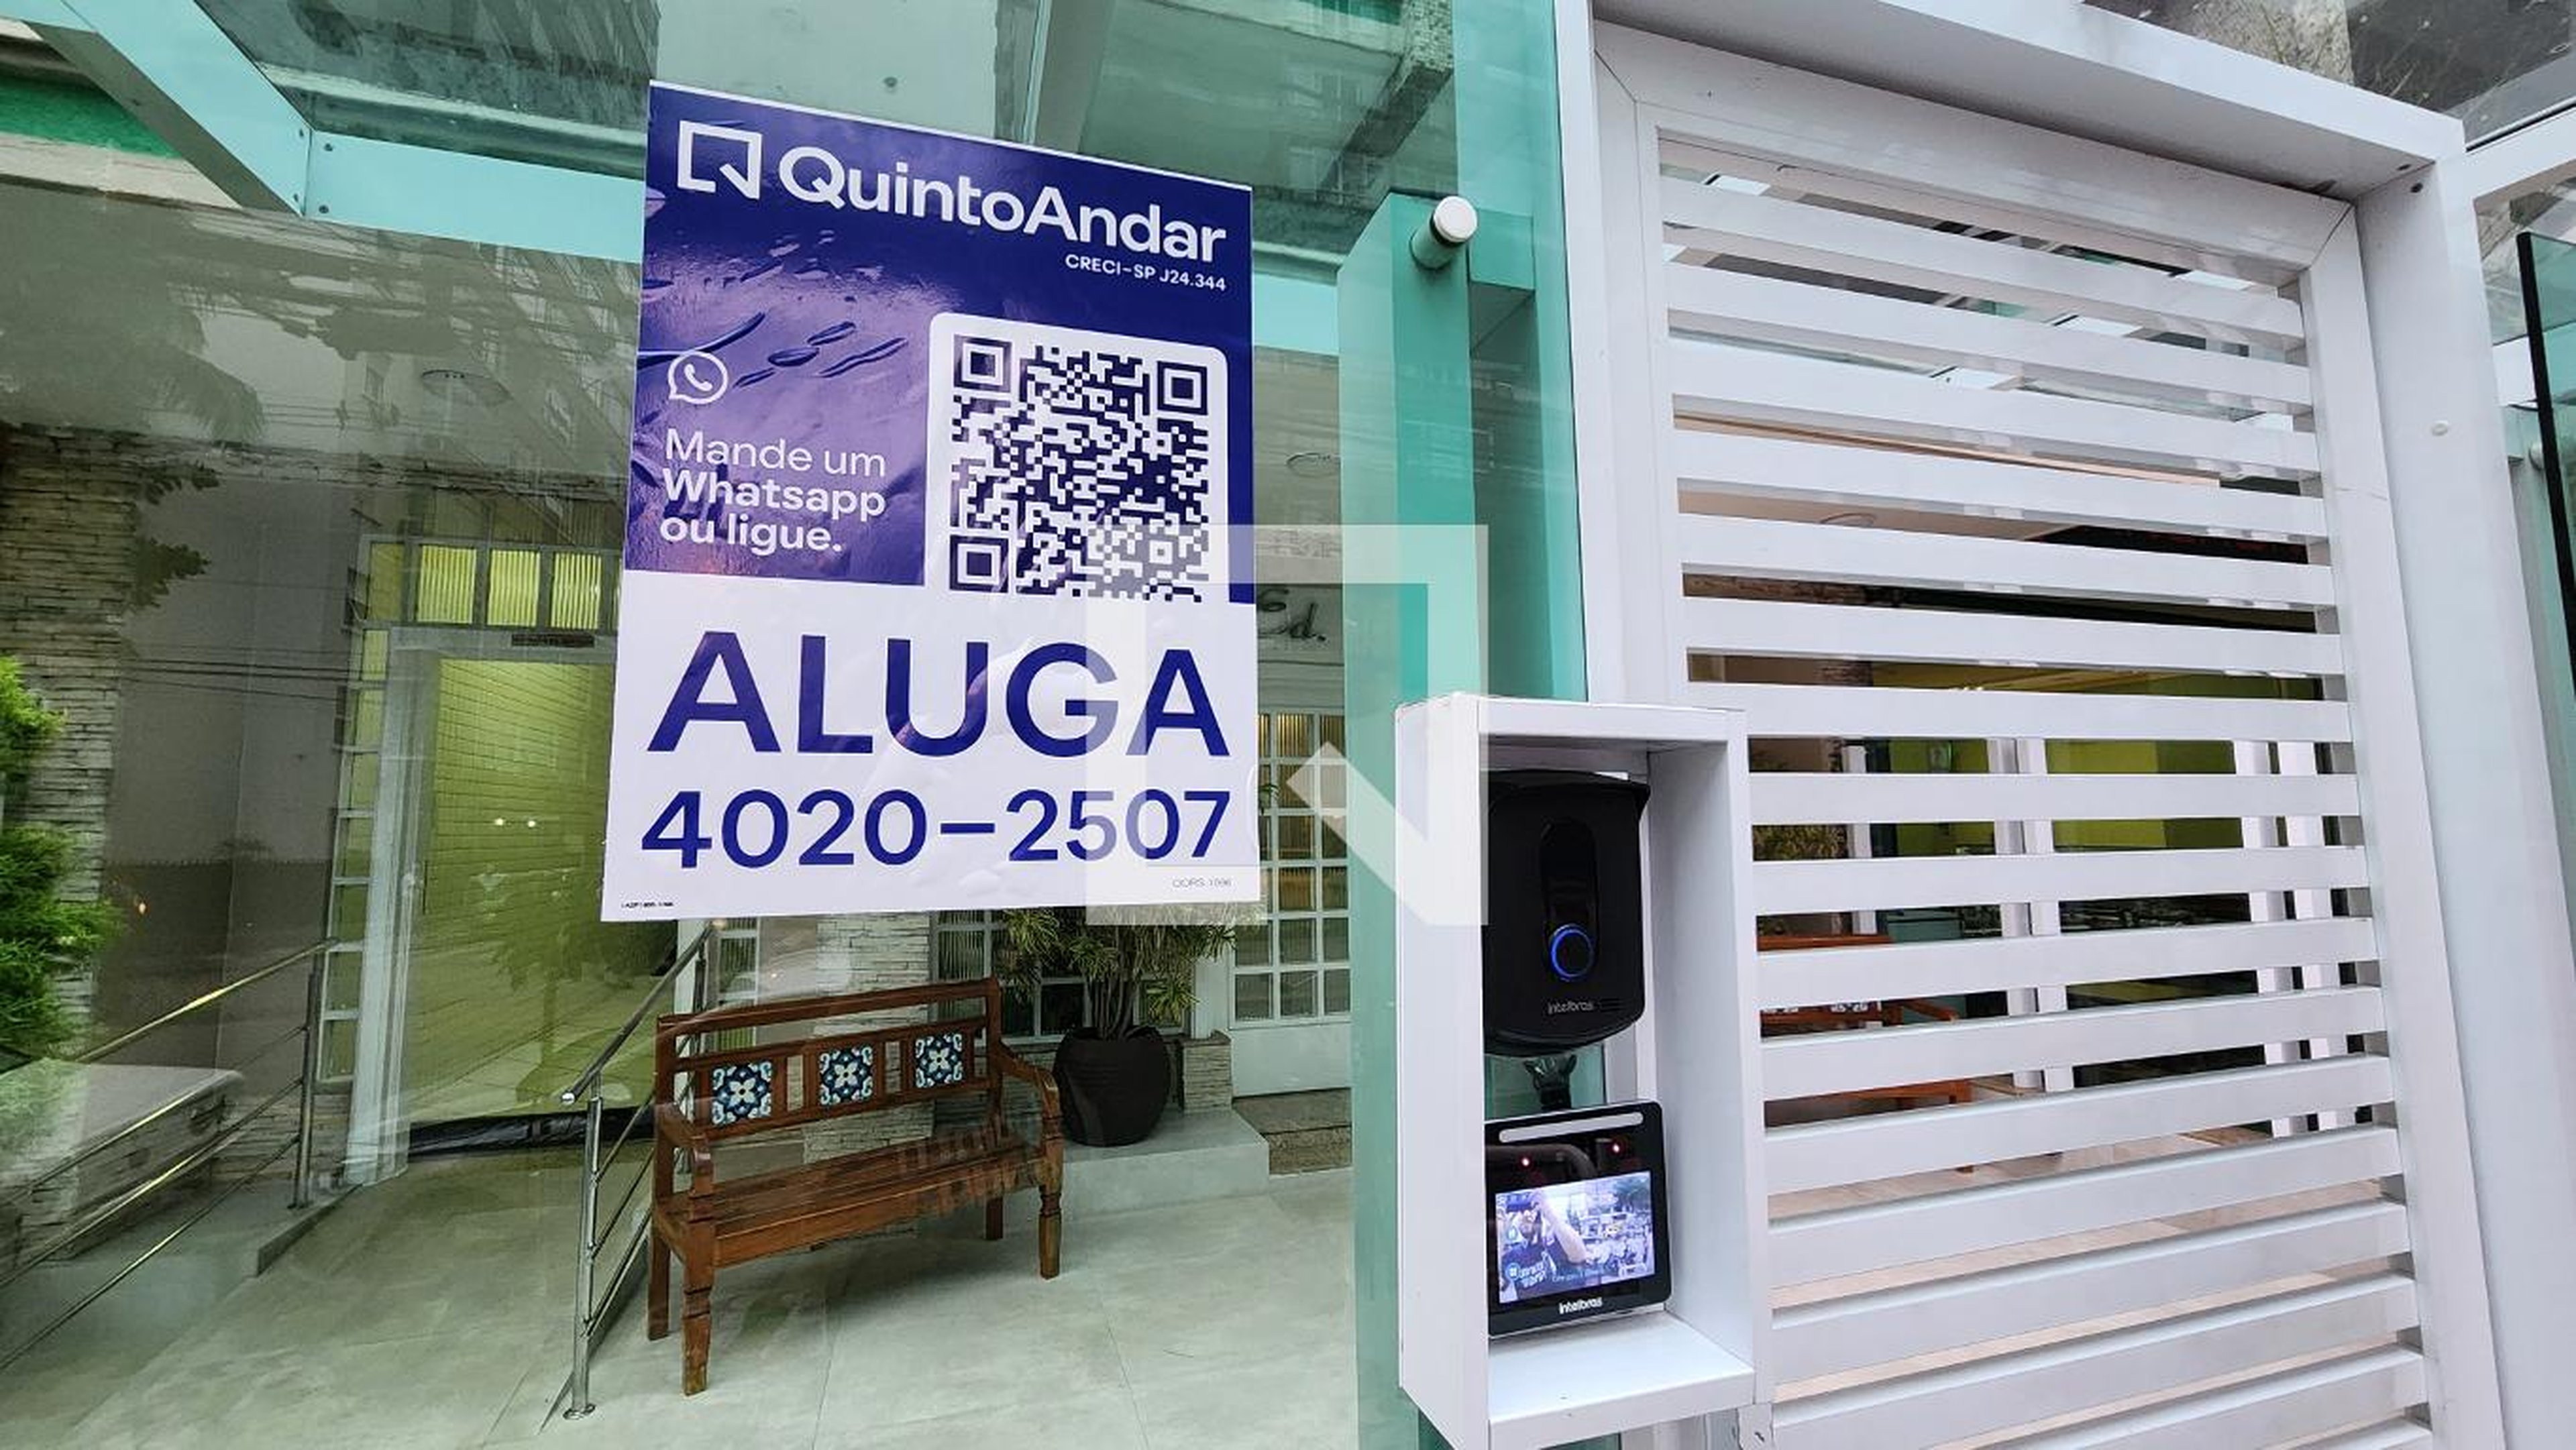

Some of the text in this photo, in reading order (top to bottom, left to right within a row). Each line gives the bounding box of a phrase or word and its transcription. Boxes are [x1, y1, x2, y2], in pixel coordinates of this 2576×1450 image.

[778, 146, 1226, 263] QuintoAndar
[1065, 254, 1227, 291] CRECI-SP J24.344
[665, 428, 885, 477] Mande um
[662, 467, 886, 522] Whatsapp
[660, 514, 843, 557] ou ligue.
[647, 630, 1231, 758] ALUGA
[641, 788, 1231, 869] 4020-2507
[1547, 1001, 1593, 1015] intelbras
[1558, 1297, 1603, 1315] intelbras
